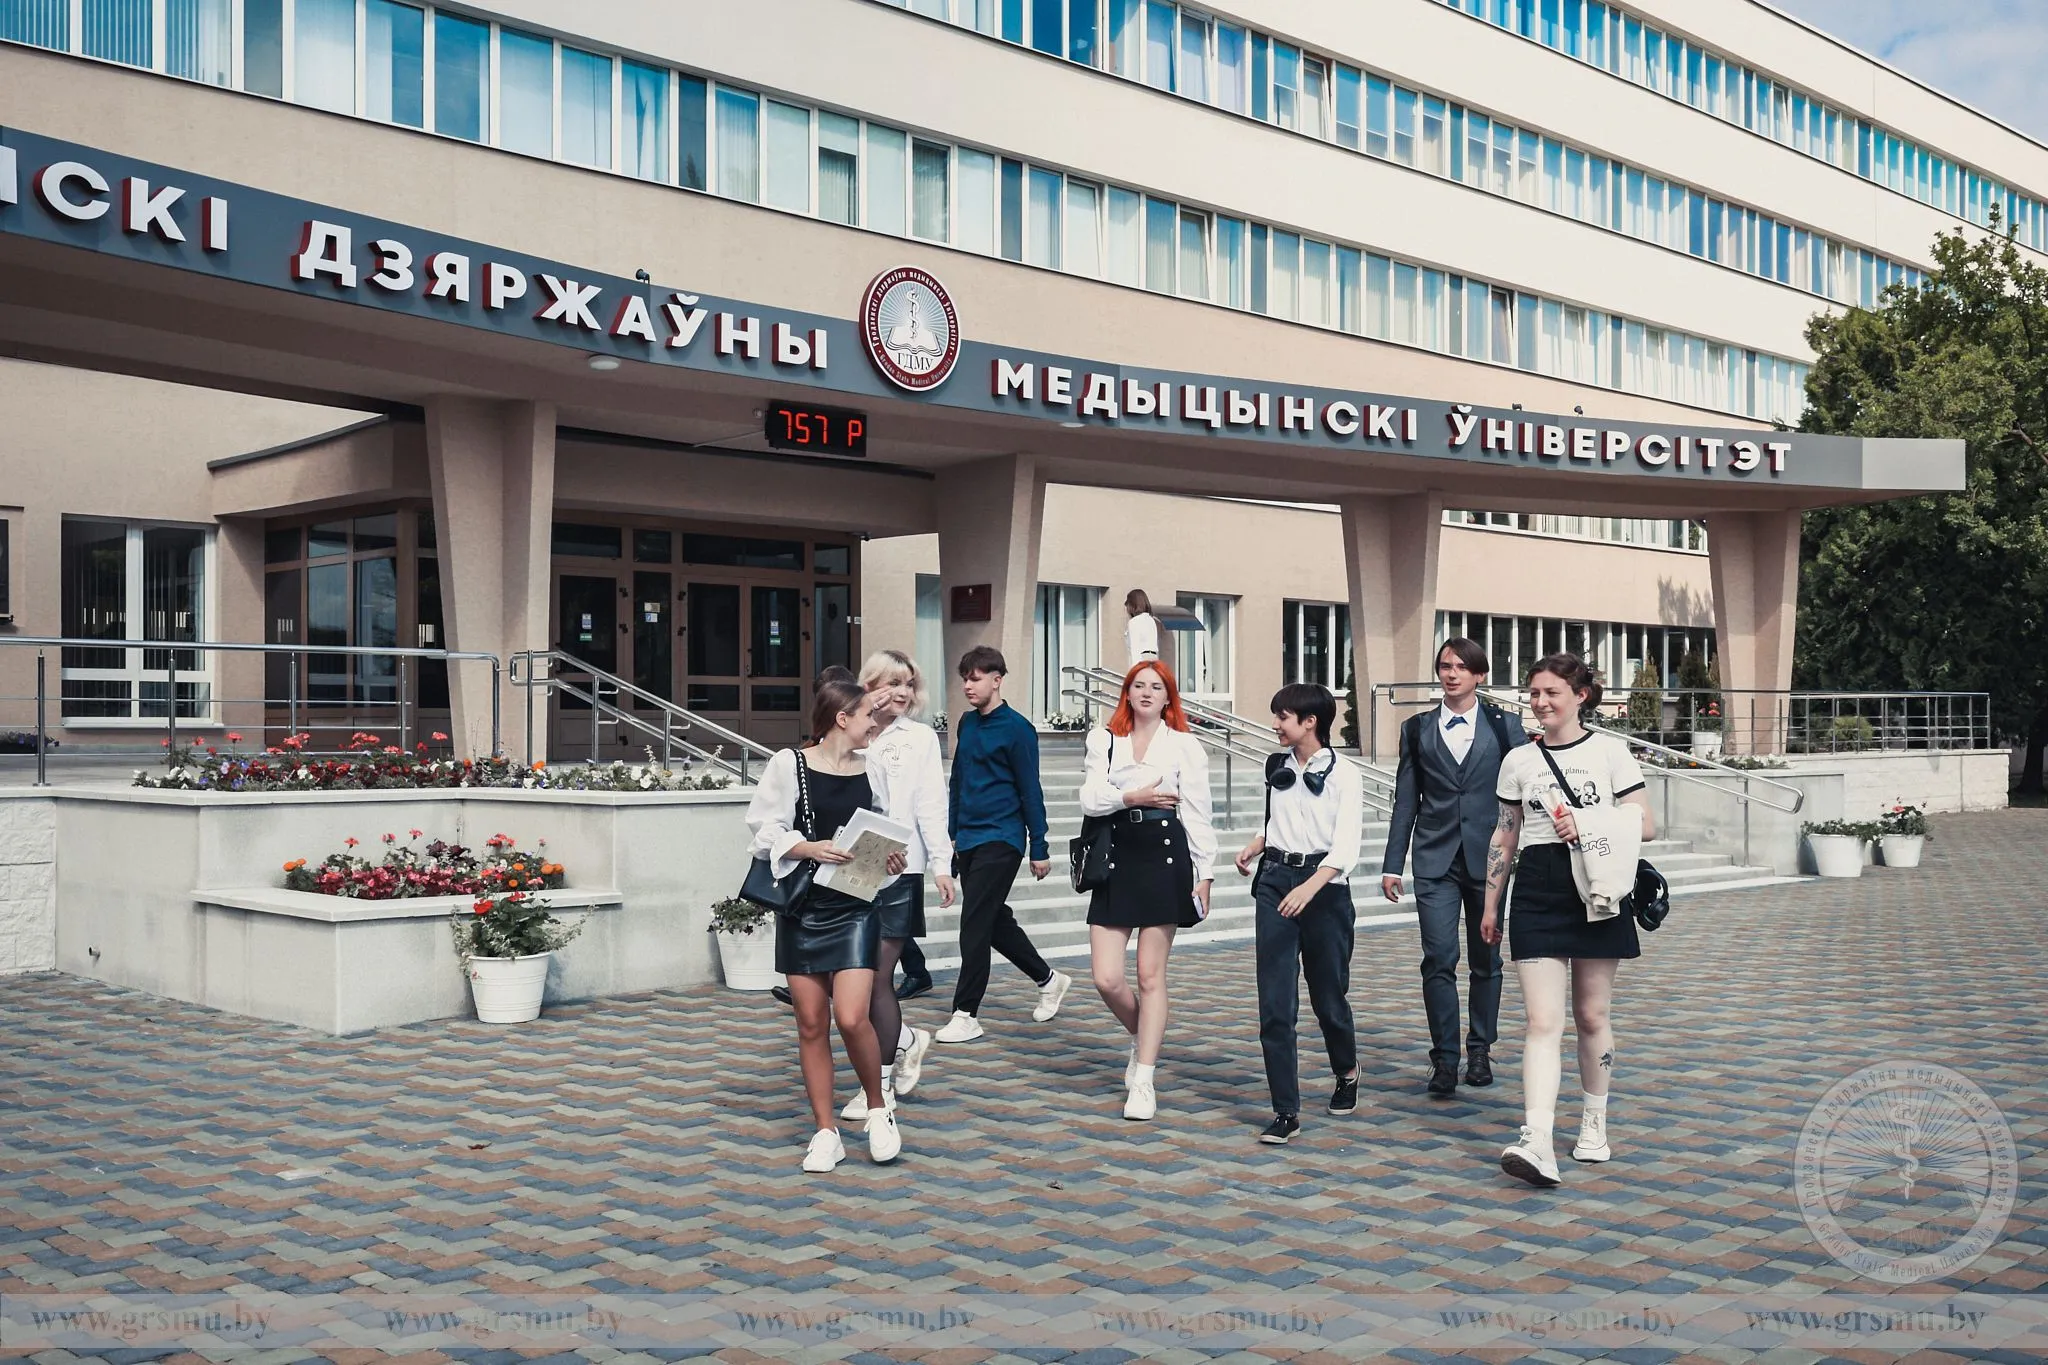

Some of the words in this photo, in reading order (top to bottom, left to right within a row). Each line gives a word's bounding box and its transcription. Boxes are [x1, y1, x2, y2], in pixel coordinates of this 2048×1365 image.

[291, 220, 829, 369] ДЗЯРЖАЎНЫ
[991, 358, 1418, 442] МЕДЫЦЫНСКІ
[1448, 404, 1792, 473] ЎНІВЕРСІТЭТ
[897, 352, 934, 371] ГДМУ
[779, 410, 828, 444] 757
